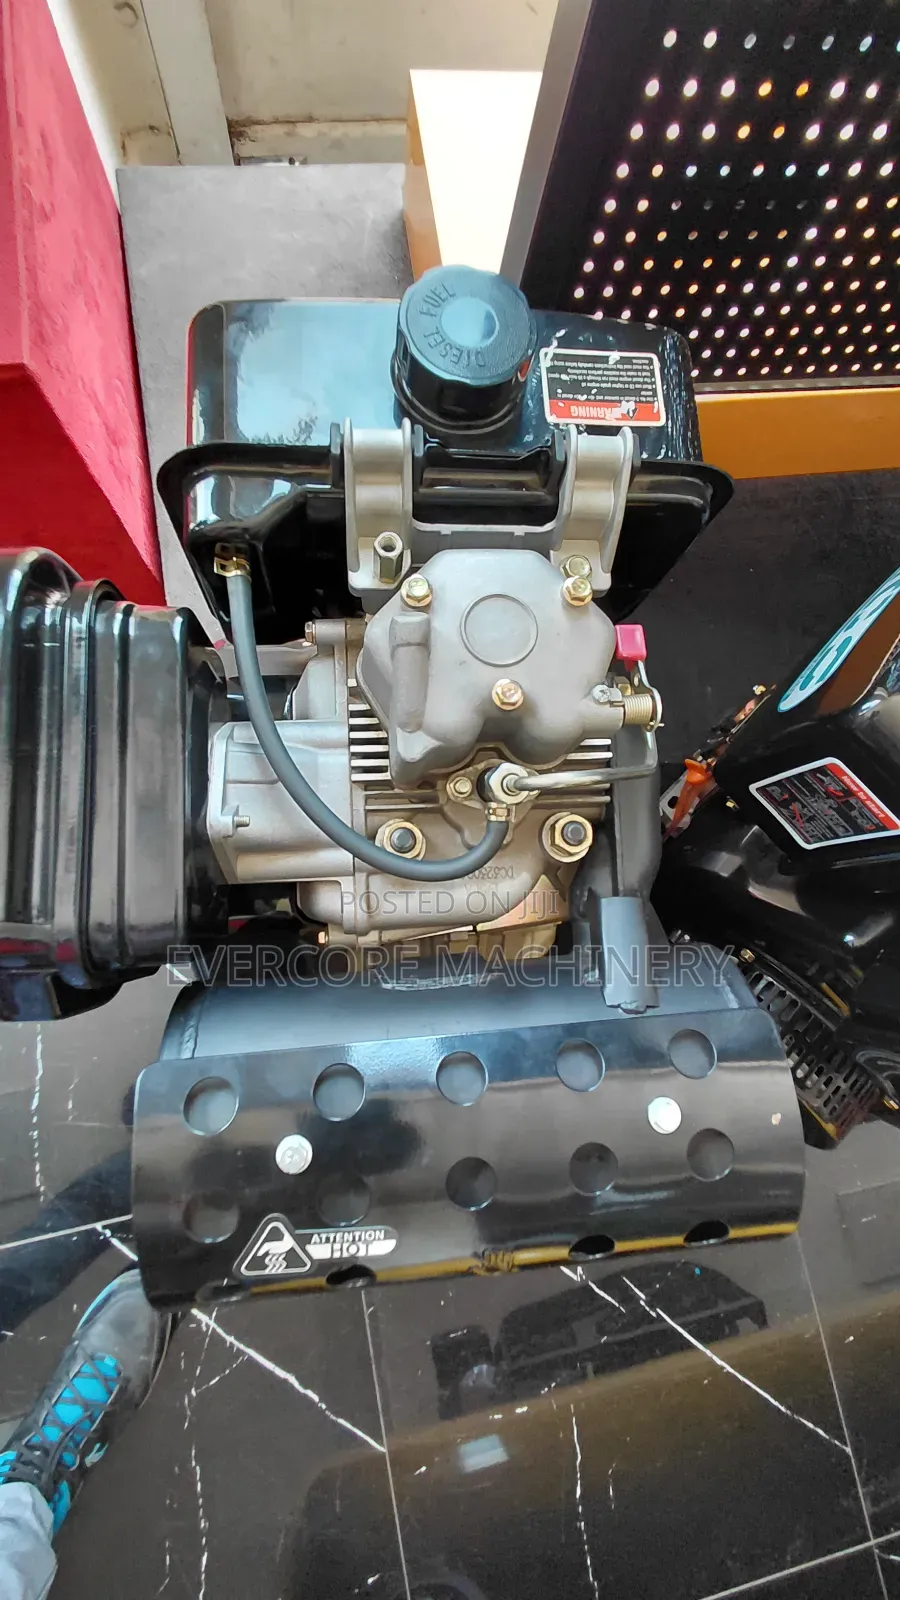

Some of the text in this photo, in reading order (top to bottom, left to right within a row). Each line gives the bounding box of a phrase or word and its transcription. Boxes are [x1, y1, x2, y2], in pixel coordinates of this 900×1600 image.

[419, 284, 456, 318] FUEL
[424, 326, 486, 368] DIESEL
[570, 406, 620, 419] ARNING
[858, 792, 866, 800] to
[310, 1230, 384, 1244] ATTENTION
[330, 1242, 373, 1258] HOT
